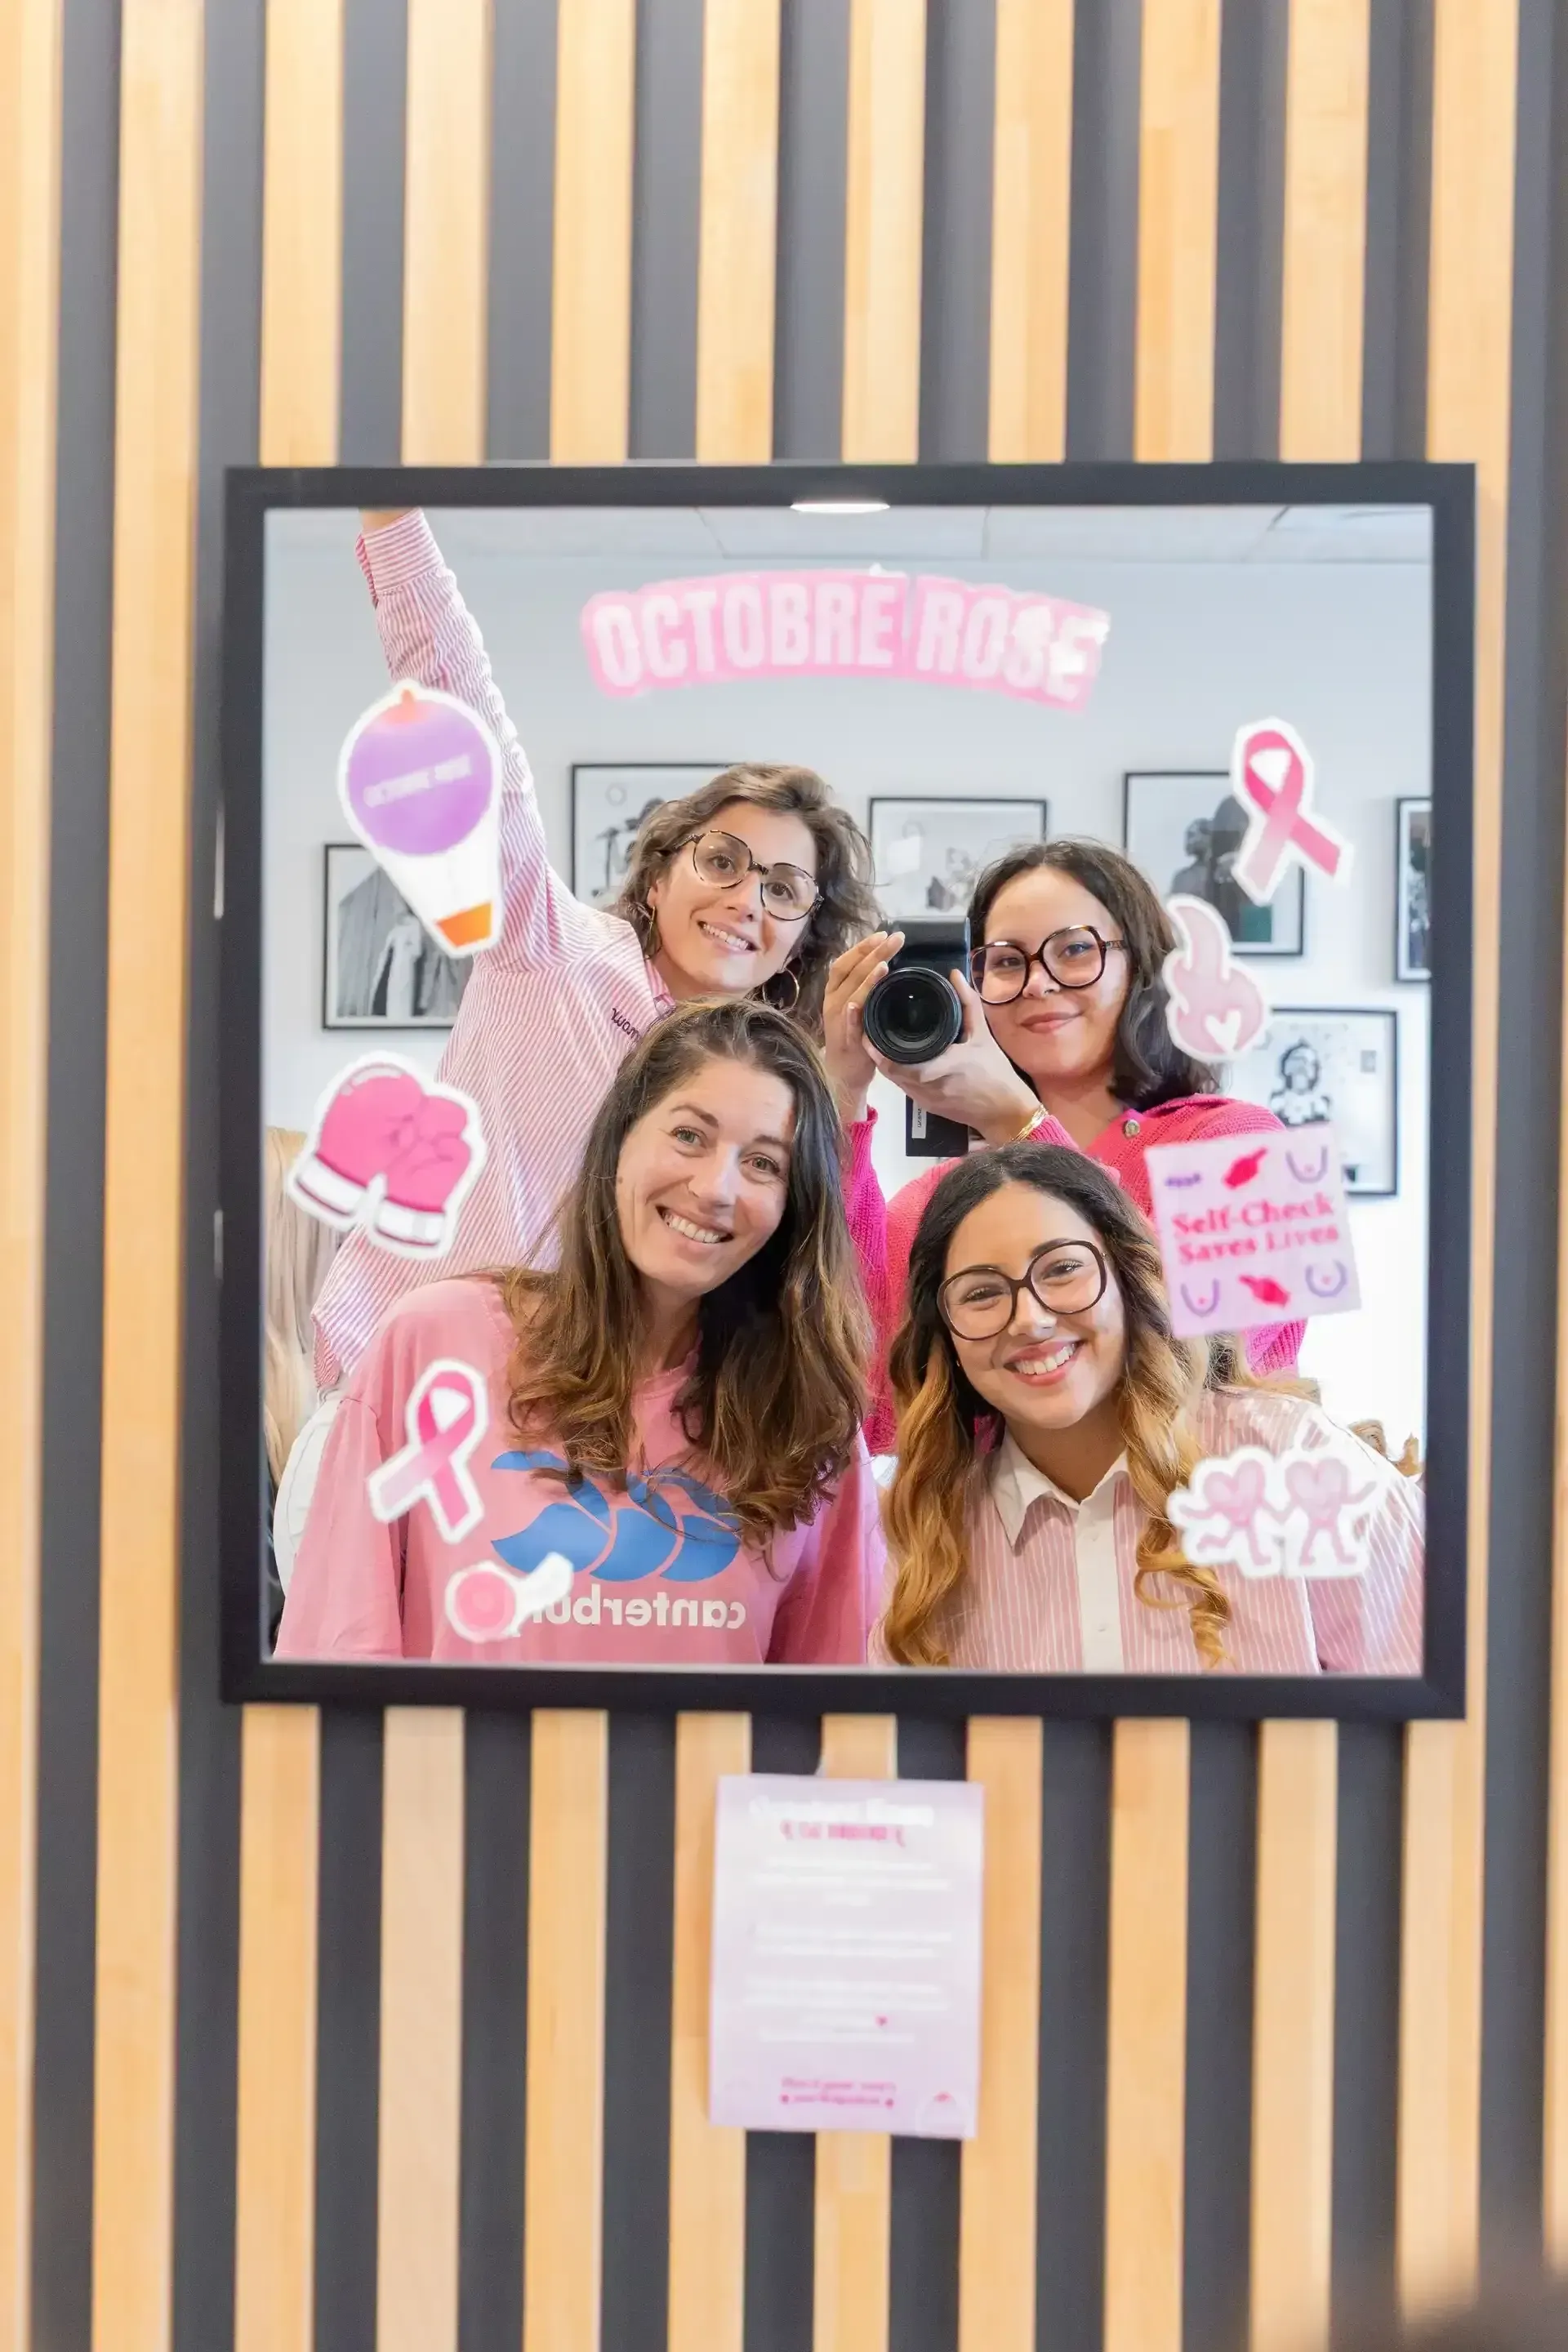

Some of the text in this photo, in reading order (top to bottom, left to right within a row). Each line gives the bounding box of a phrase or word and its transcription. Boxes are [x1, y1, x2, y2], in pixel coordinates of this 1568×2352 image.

[593, 581, 1107, 702] OCTOBRE ROSE
[1178, 1223, 1339, 1265] Saves Lives
